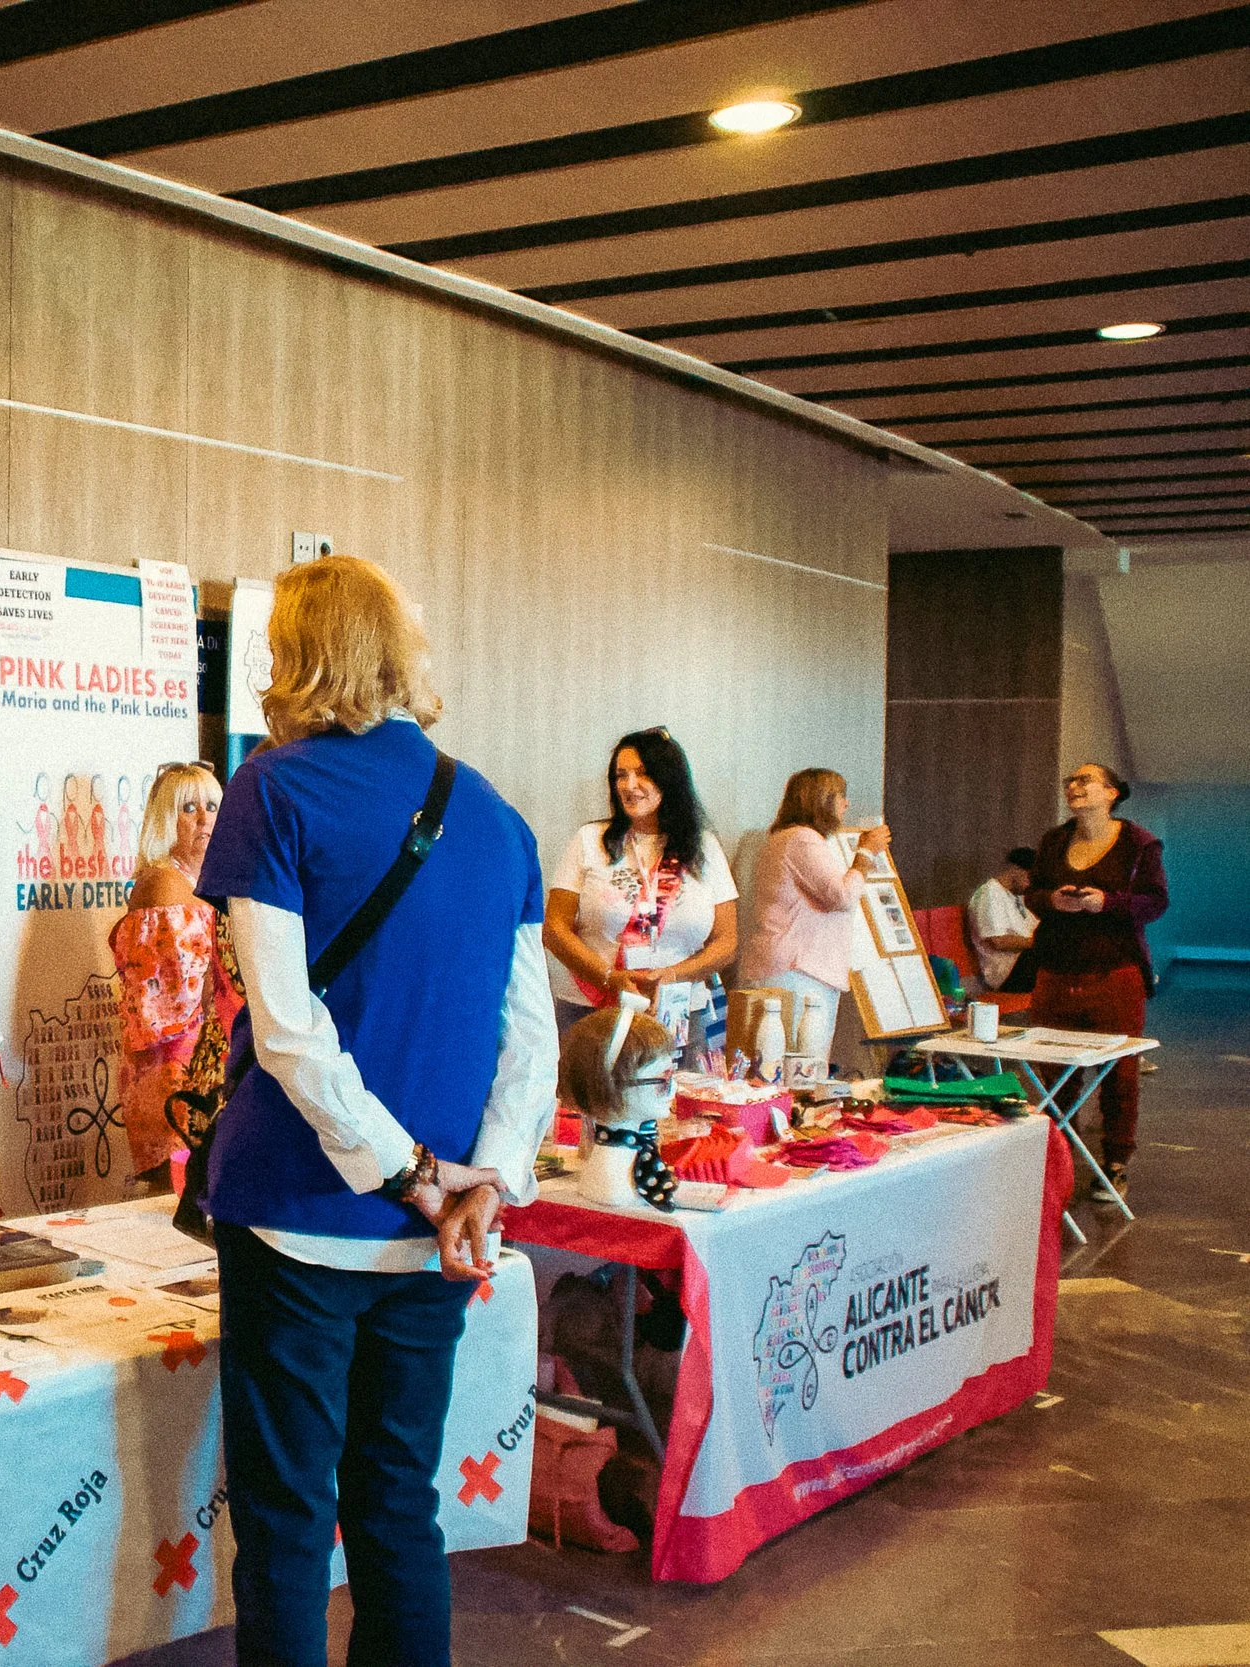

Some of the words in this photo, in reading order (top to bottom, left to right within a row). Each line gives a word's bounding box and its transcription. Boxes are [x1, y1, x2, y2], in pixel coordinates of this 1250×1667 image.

[10, 570, 39, 581] EARLY
[28, 608, 54, 620] LIVES
[0, 655, 66, 690] PINK
[75, 662, 188, 700] LADIES.es
[2, 690, 47, 710] Maria
[53, 694, 80, 712] and
[85, 696, 106, 714] the
[112, 697, 141, 717] Pink
[145, 701, 188, 719] Ladies
[17, 843, 51, 879] the
[60, 843, 105, 879] best
[111, 855, 139, 879] cu
[16, 882, 76, 911] EARLY
[83, 881, 136, 909] DETEC
[844, 1264, 930, 1335] ALICANTE
[842, 1314, 916, 1379] CONTRA
[918, 1305, 940, 1346] EL
[943, 1276, 1001, 1334] CÁNCR
[497, 1403, 535, 1452] Cruz
[16, 1522, 67, 1583] Cruz
[57, 1469, 109, 1527] Roja
[196, 1486, 228, 1531] Cru
